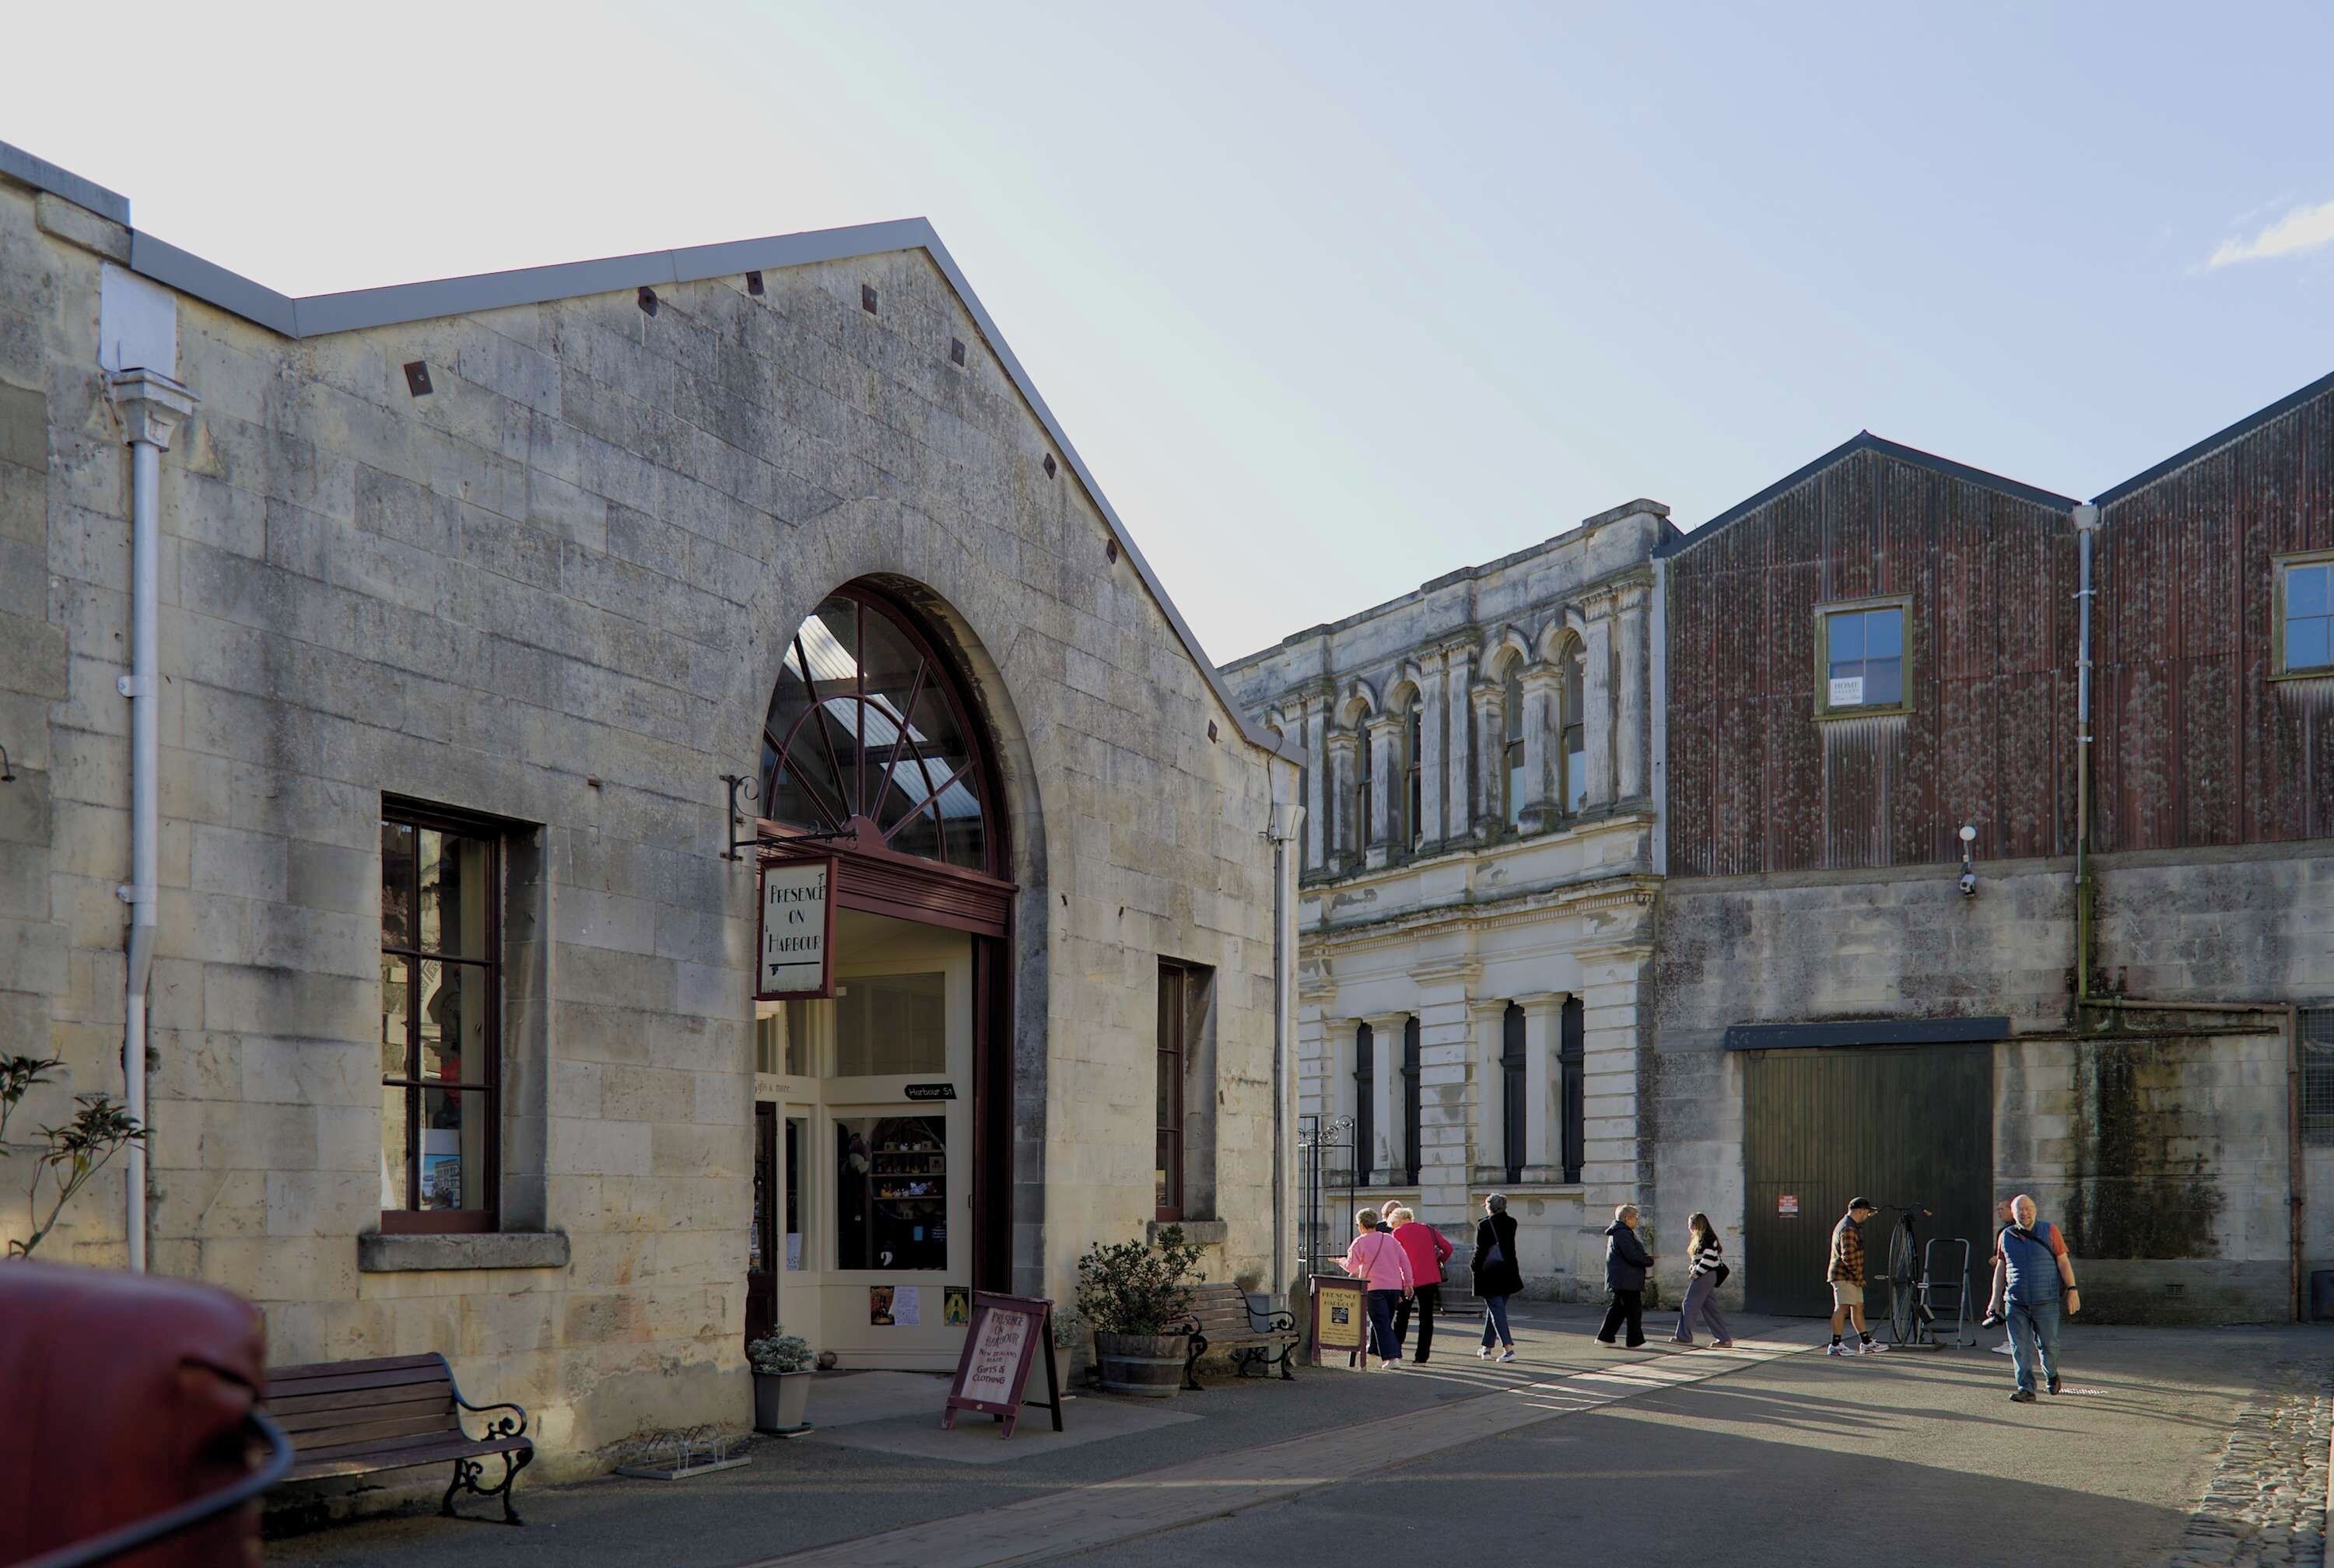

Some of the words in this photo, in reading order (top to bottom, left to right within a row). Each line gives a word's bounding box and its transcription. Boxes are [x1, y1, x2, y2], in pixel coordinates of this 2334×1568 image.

[770, 884, 825, 904] PRESENCE
[788, 909, 804, 924] ON
[769, 933, 822, 952] HARBOUR
[909, 1087, 940, 1096] Harbour
[943, 1087, 953, 1096] St
[991, 1312, 1023, 1326] PRESENCE
[994, 1325, 1003, 1335] ON
[985, 1332, 1019, 1348] HARBOUR
[976, 1365, 998, 1374] GIFTS
[972, 1374, 1006, 1384] CLOTHING
